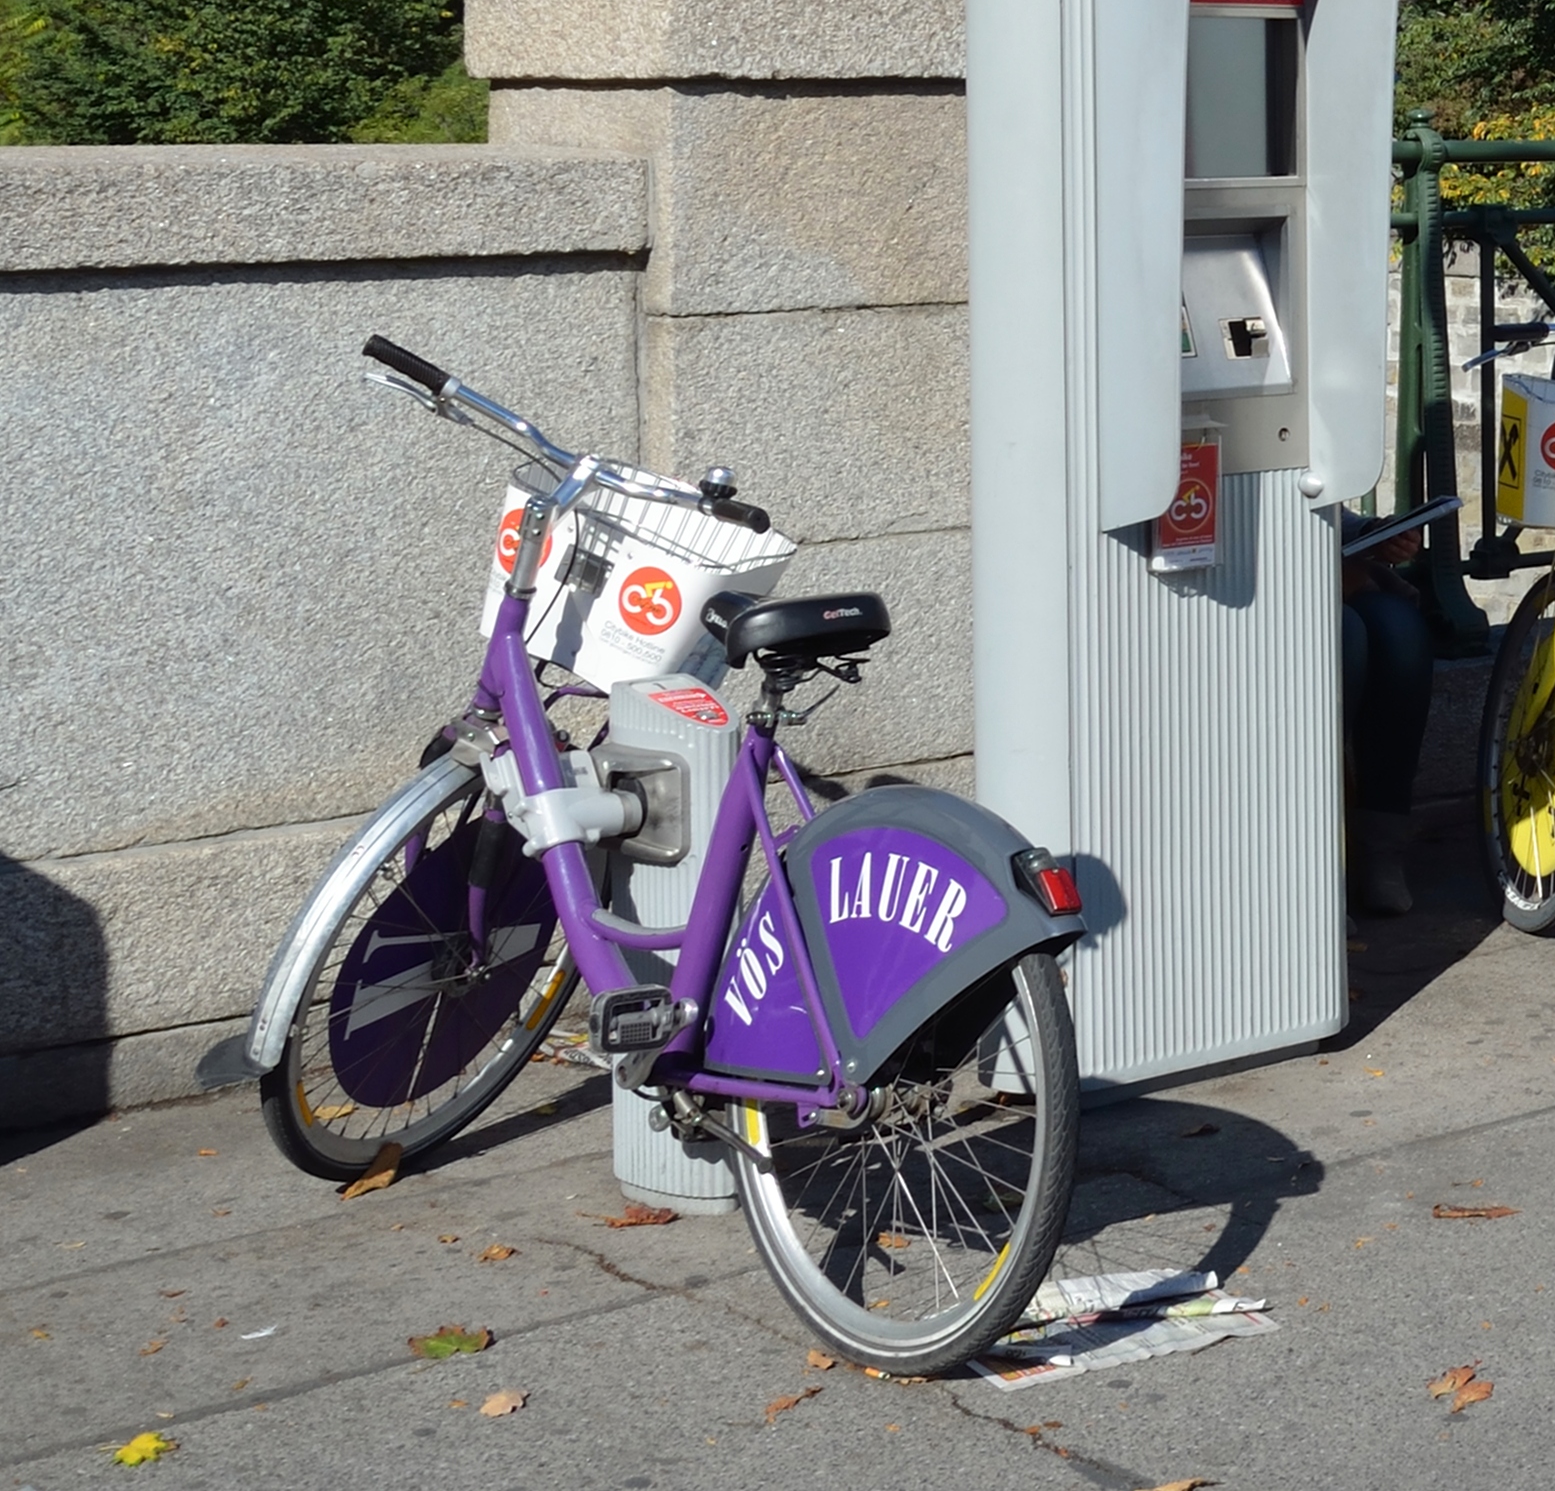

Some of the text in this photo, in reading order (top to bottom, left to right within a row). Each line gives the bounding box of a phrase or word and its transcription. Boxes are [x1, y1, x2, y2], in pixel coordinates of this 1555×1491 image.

[604, 620, 634, 641] Citybike
[635, 636, 666, 654] Hotline
[724, 851, 968, 1026] VÖS LAUER
